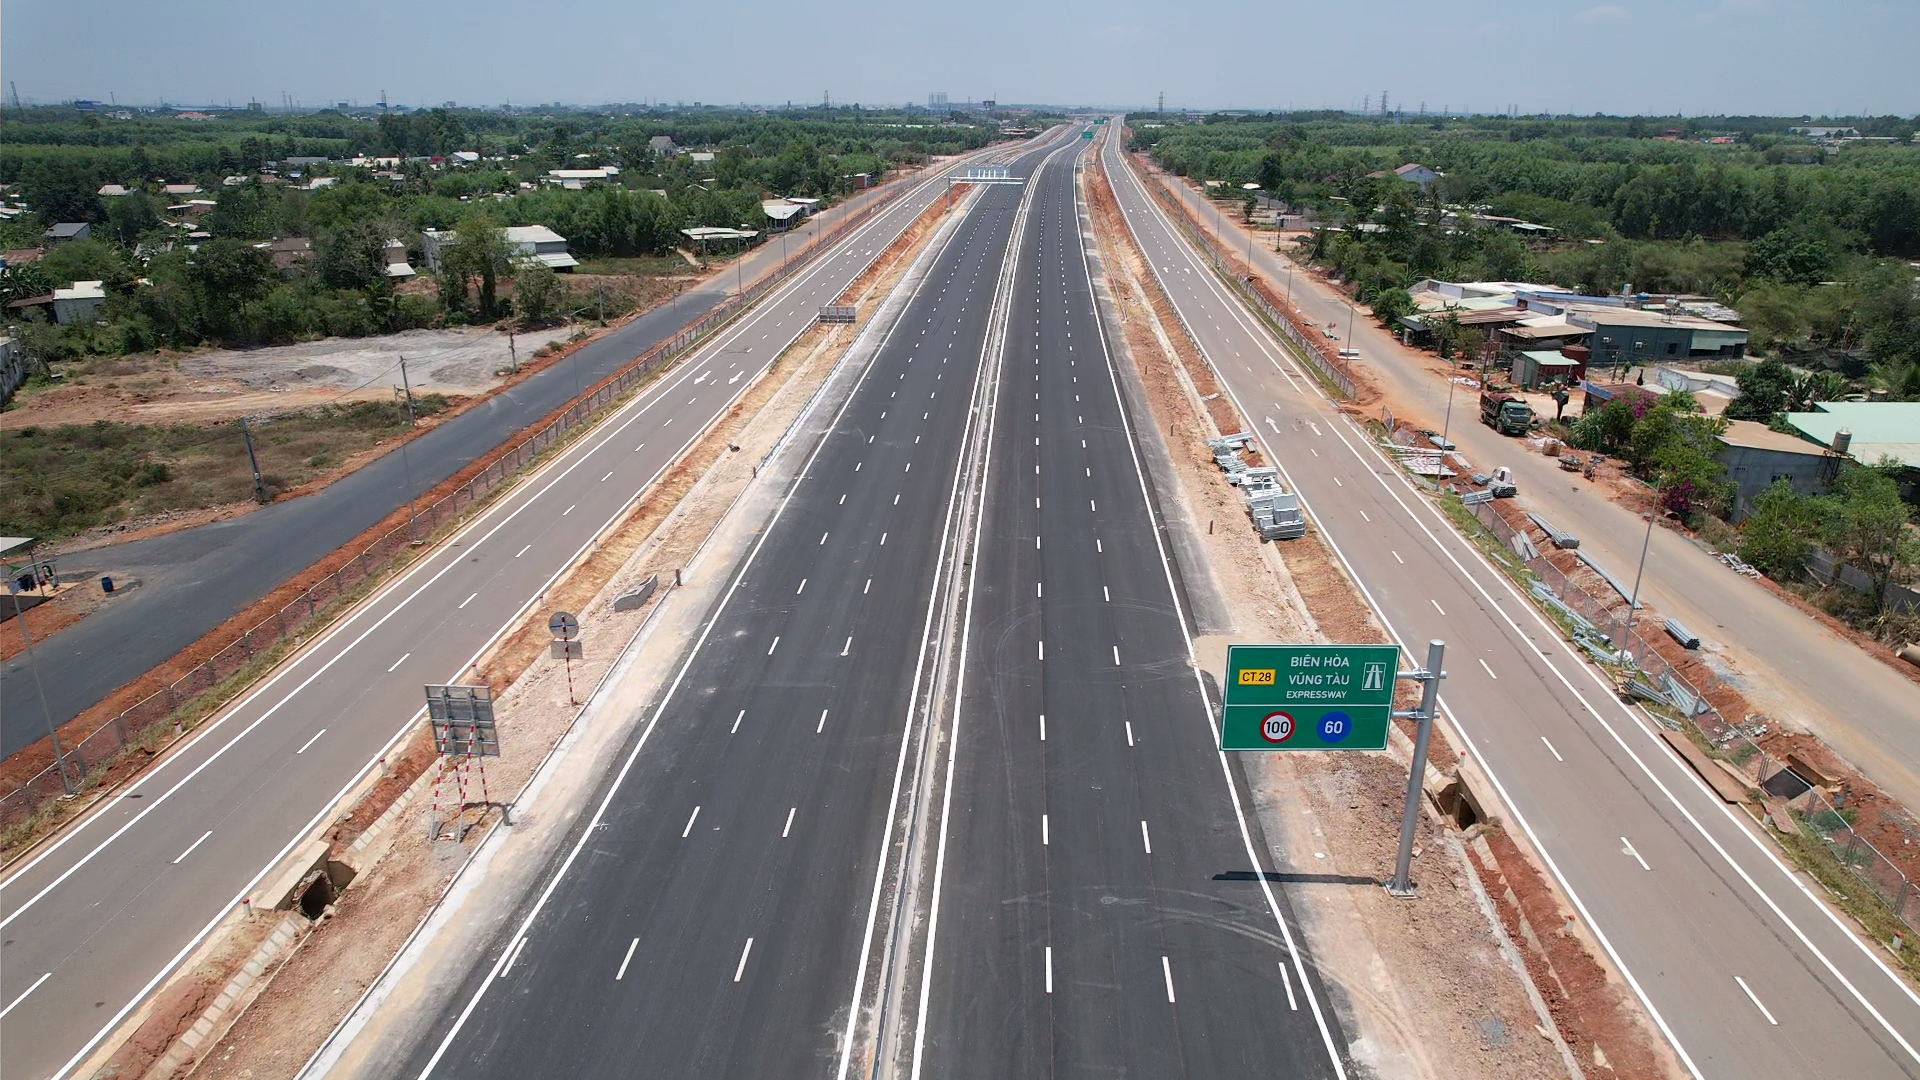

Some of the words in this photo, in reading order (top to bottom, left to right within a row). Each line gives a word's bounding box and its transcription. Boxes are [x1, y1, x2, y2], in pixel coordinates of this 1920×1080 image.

[1291, 654, 1320, 667] BIÊN
[1324, 654, 1350, 667] HÒA
[1242, 672, 1272, 682] CT.28
[1289, 672, 1322, 685] VŨNG
[1326, 672, 1350, 685] TÀU
[1286, 690, 1347, 699] EXPRESSWAY
[1266, 721, 1289, 734] 100
[1324, 721, 1343, 734] 60
